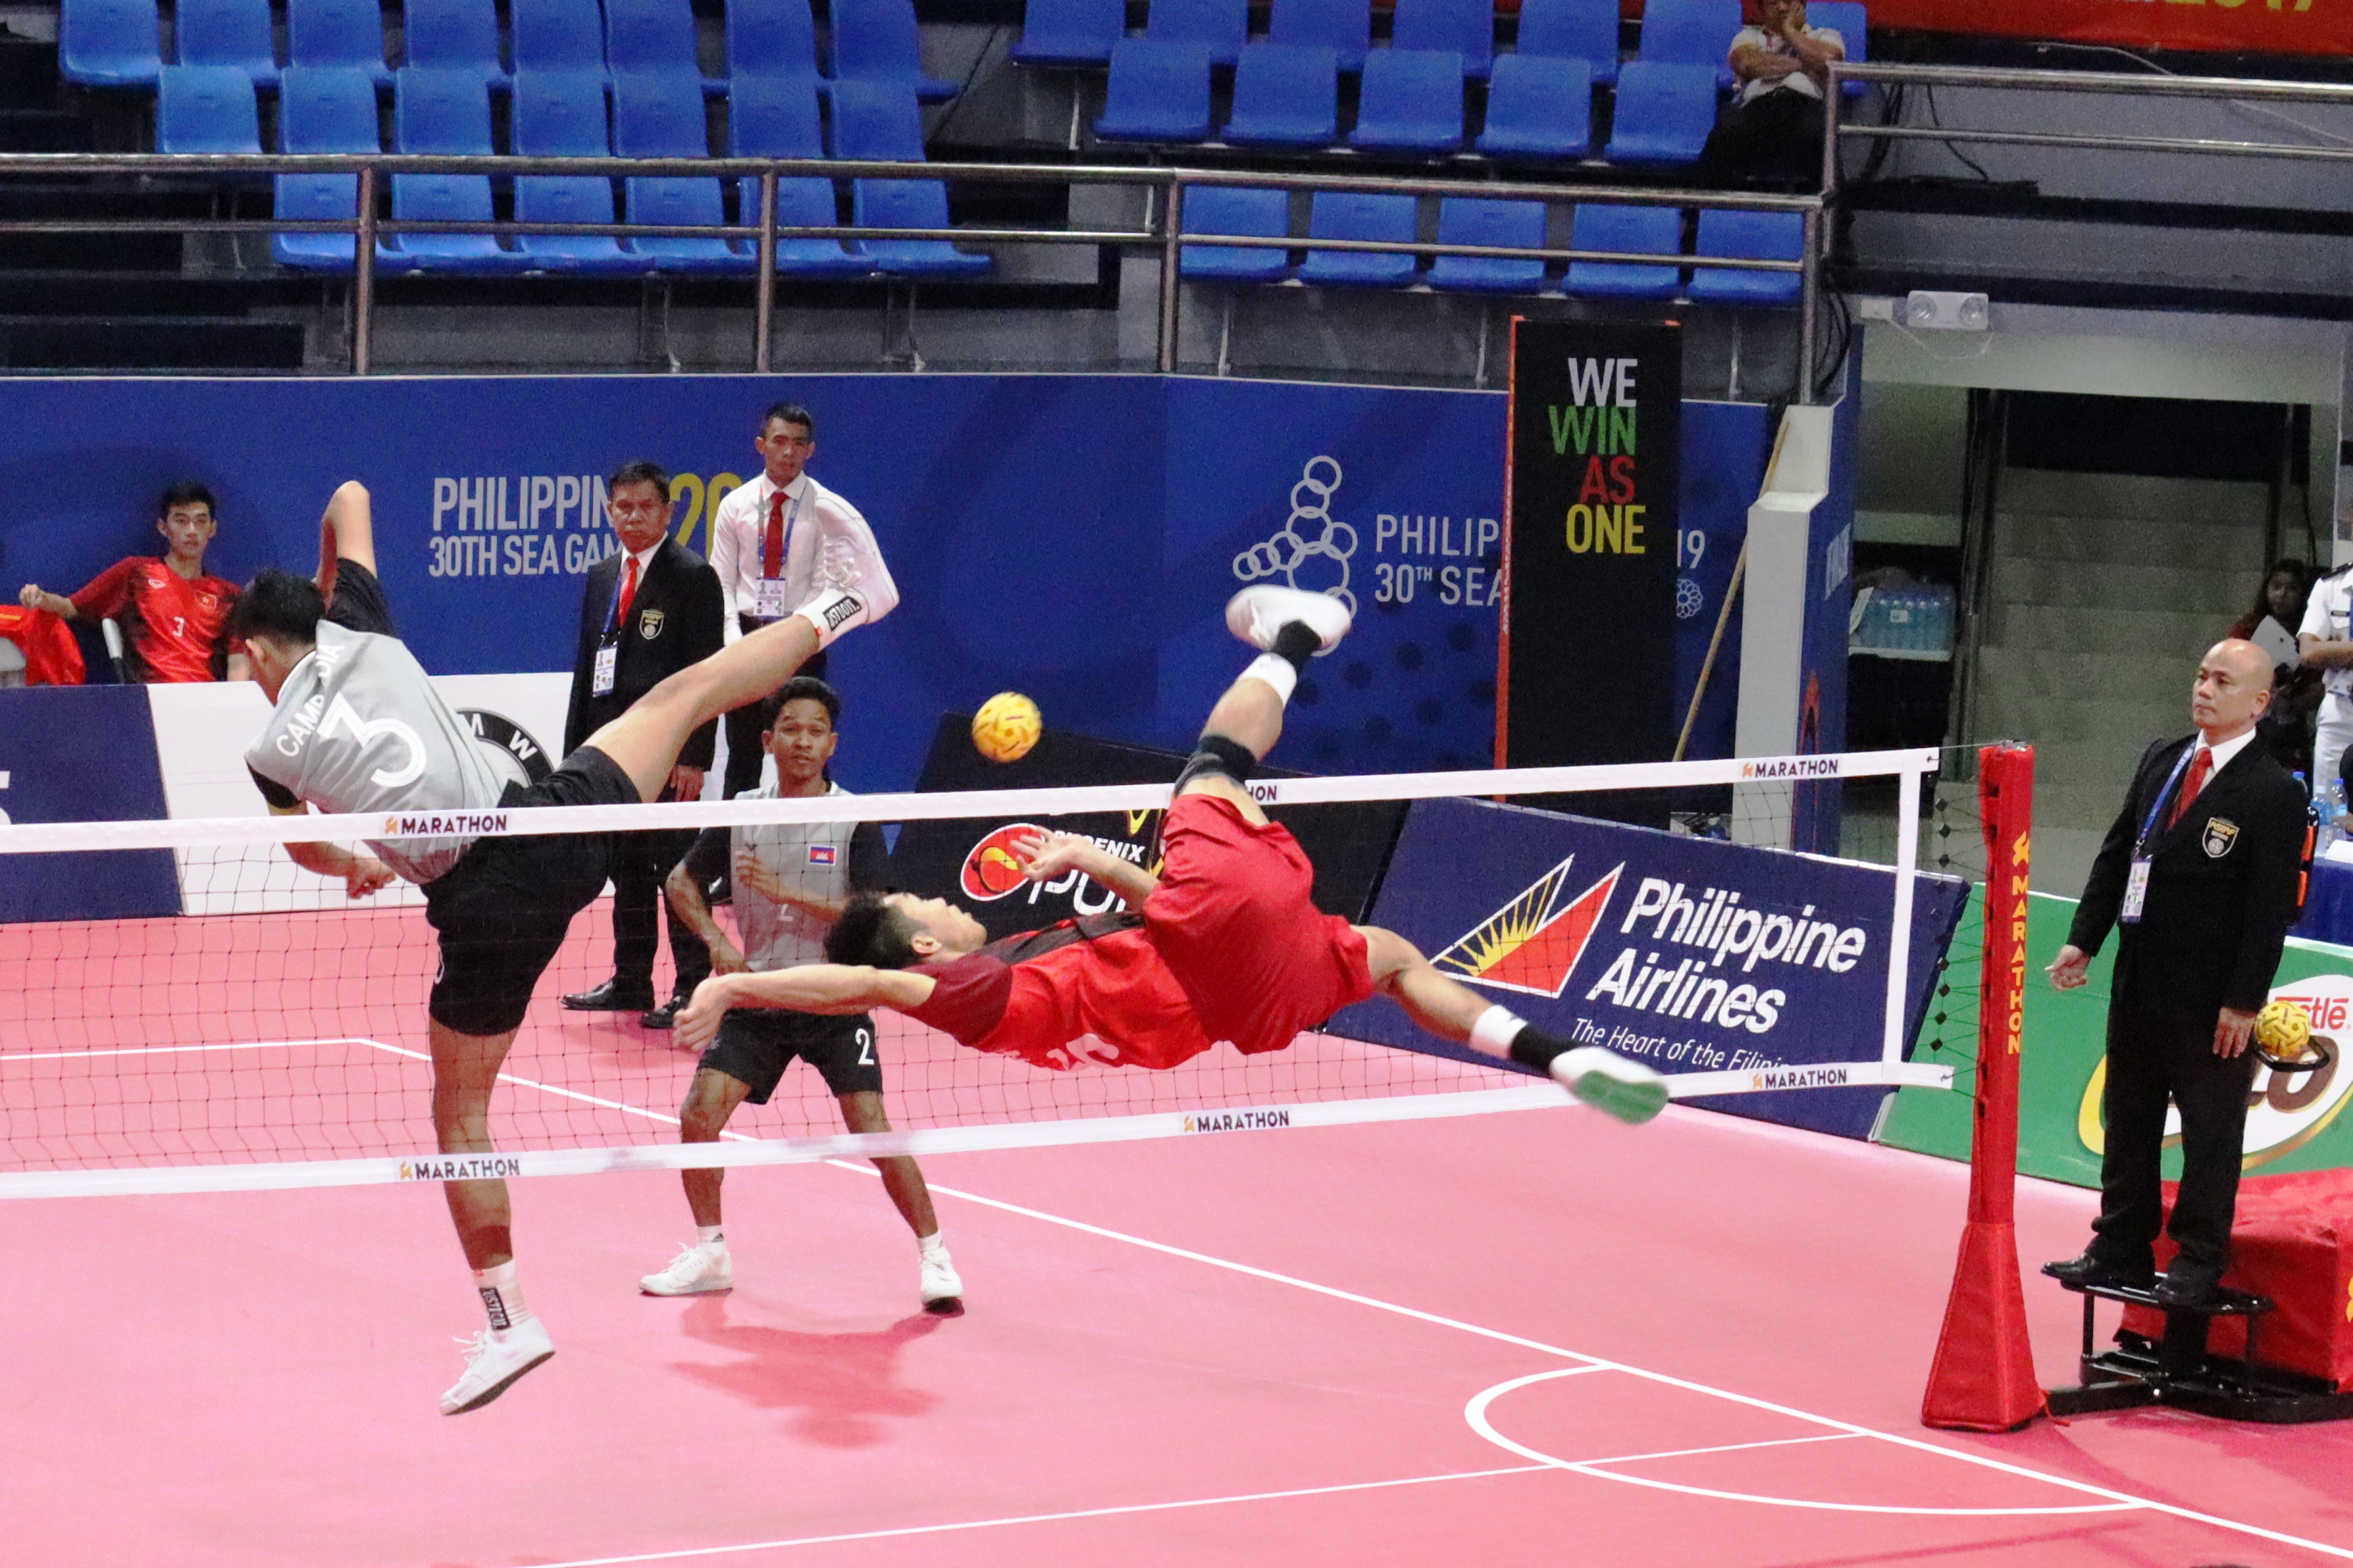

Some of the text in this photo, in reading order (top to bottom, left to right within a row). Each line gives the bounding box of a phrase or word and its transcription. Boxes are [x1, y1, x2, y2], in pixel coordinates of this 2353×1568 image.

[1568, 357, 1637, 407] WE
[1548, 405, 1637, 456] WIN
[1579, 456, 1635, 505] AS
[433, 473, 745, 562] PHILIPPIN 20
[1375, 514, 1706, 569] PHILIP 19
[1566, 503, 1646, 554] ONE
[429, 535, 498, 577] 30TH
[503, 534, 560, 576] SEA
[1375, 563, 1432, 604] 30TH
[172, 616, 185, 638] 3
[316, 690, 427, 788] 3
[1755, 759, 1838, 779] MARATHON
[401, 814, 507, 835] MARATHON
[1054, 831, 1146, 862] ENIX
[1620, 877, 1866, 973] Philippine
[2008, 874, 2028, 1055] MARATHON
[1587, 947, 1786, 1033] Airlines
[855, 1028, 875, 1065] 2
[1571, 1018, 1605, 1045] The
[1607, 1025, 1667, 1057] Heart
[1667, 1038, 1696, 1061] of
[1691, 1042, 1725, 1068] the
[1765, 1069, 1847, 1089] MARATHON
[1198, 1110, 1290, 1132] MARATHON
[415, 1159, 520, 1180] MARATHON
